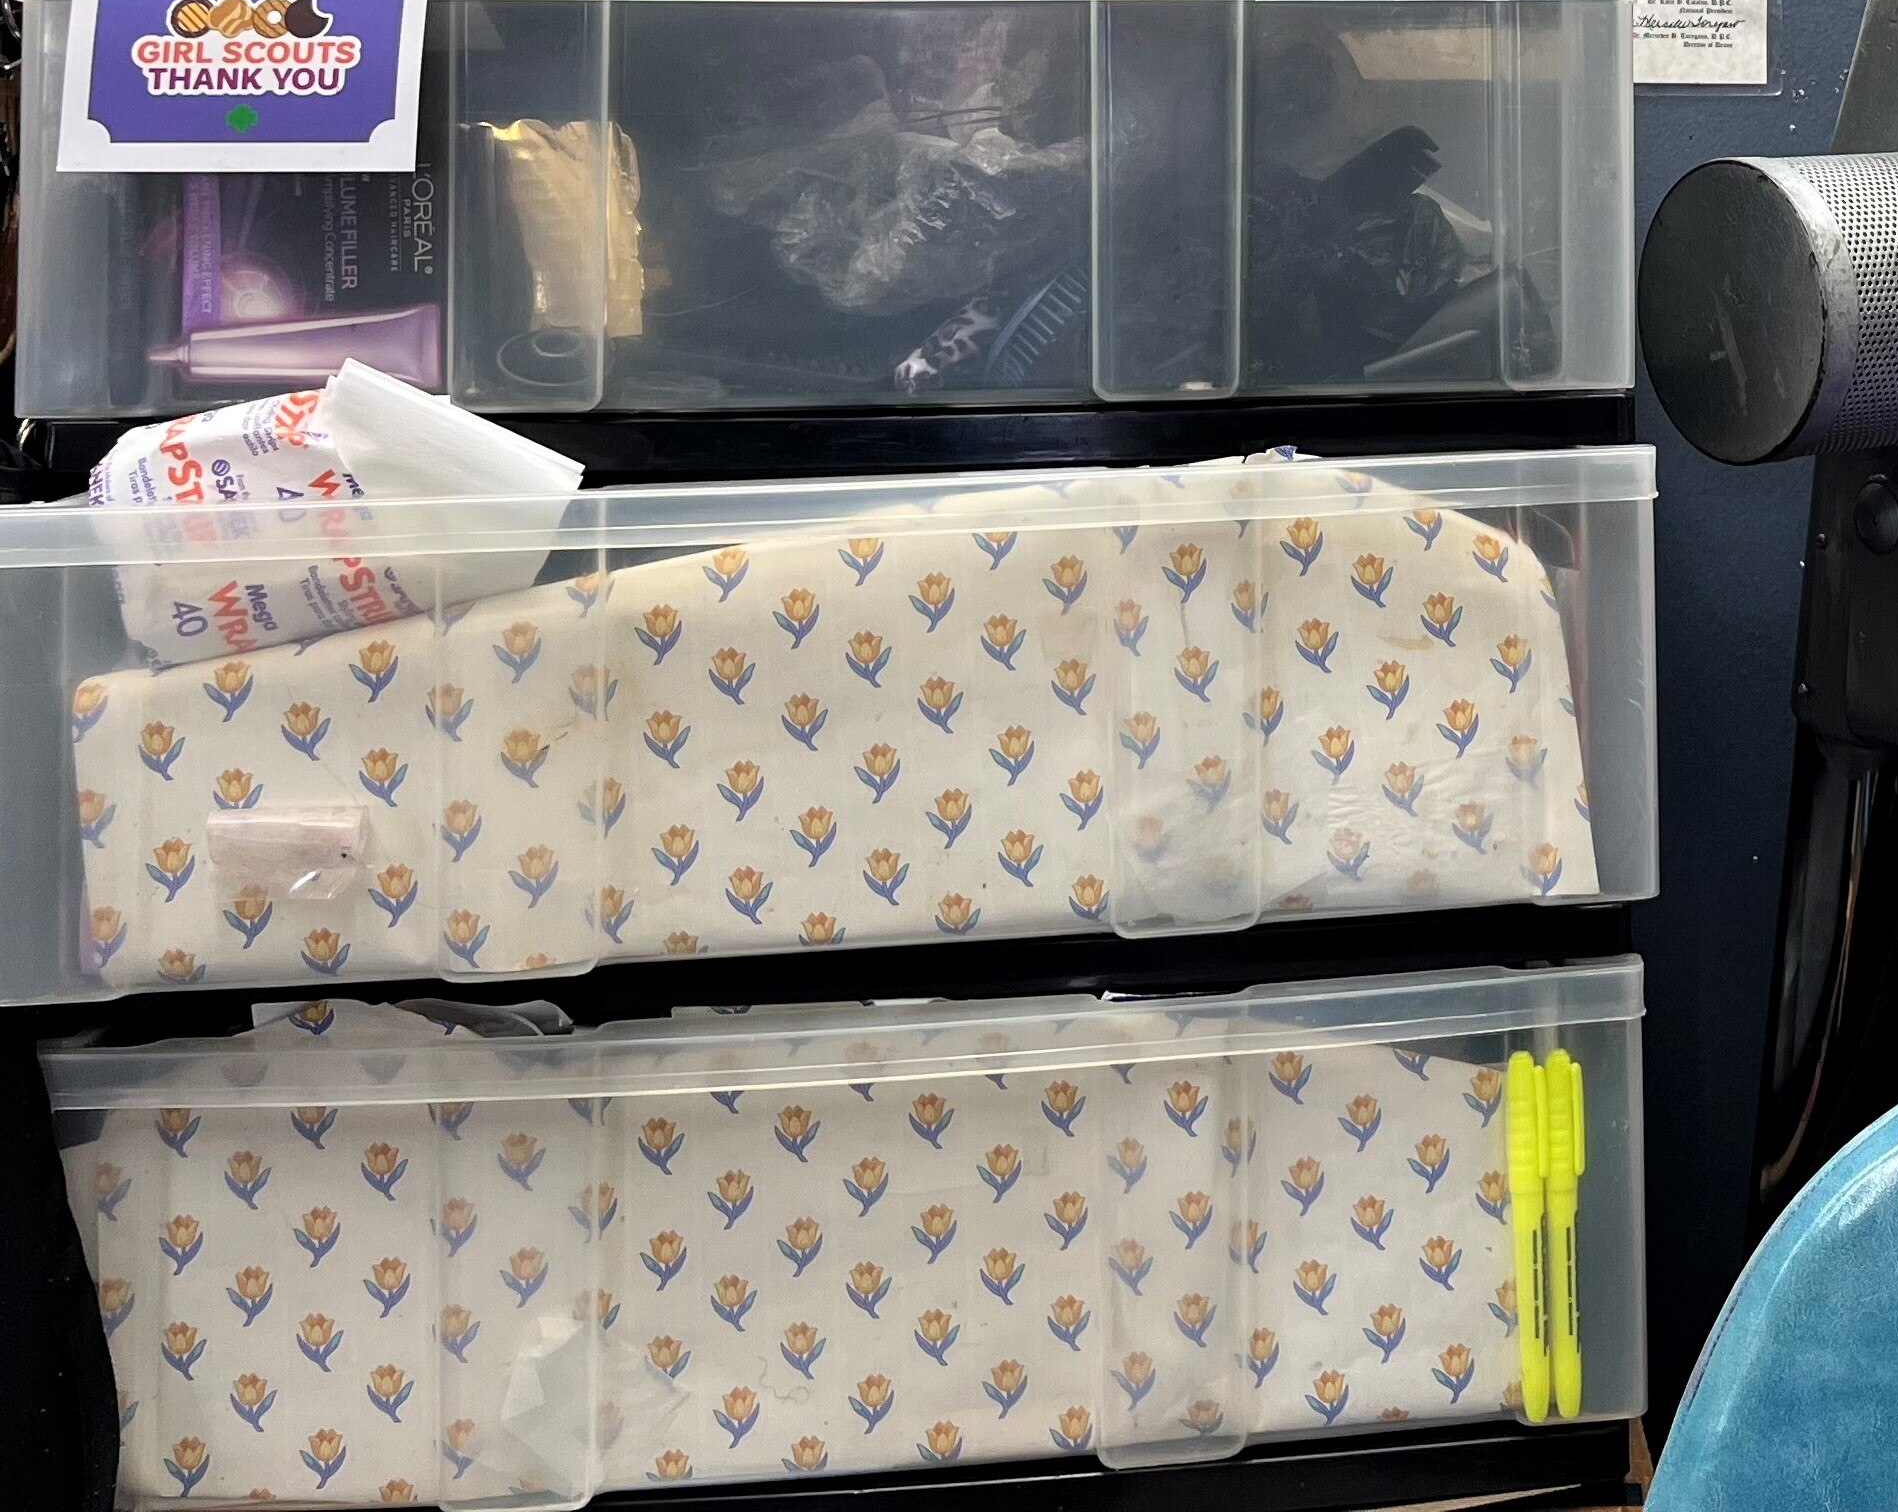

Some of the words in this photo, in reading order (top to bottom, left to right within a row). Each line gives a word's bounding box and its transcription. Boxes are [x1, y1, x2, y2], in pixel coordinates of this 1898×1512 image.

[138, 41, 213, 64] GIRL
[222, 41, 355, 64] SCOUTS
[149, 67, 264, 90] THANK
[273, 68, 339, 90] YOU
[403, 199, 411, 238] PARIS
[341, 230, 357, 289] FILLER
[172, 600, 208, 638] 40
[246, 584, 278, 632] Mega
